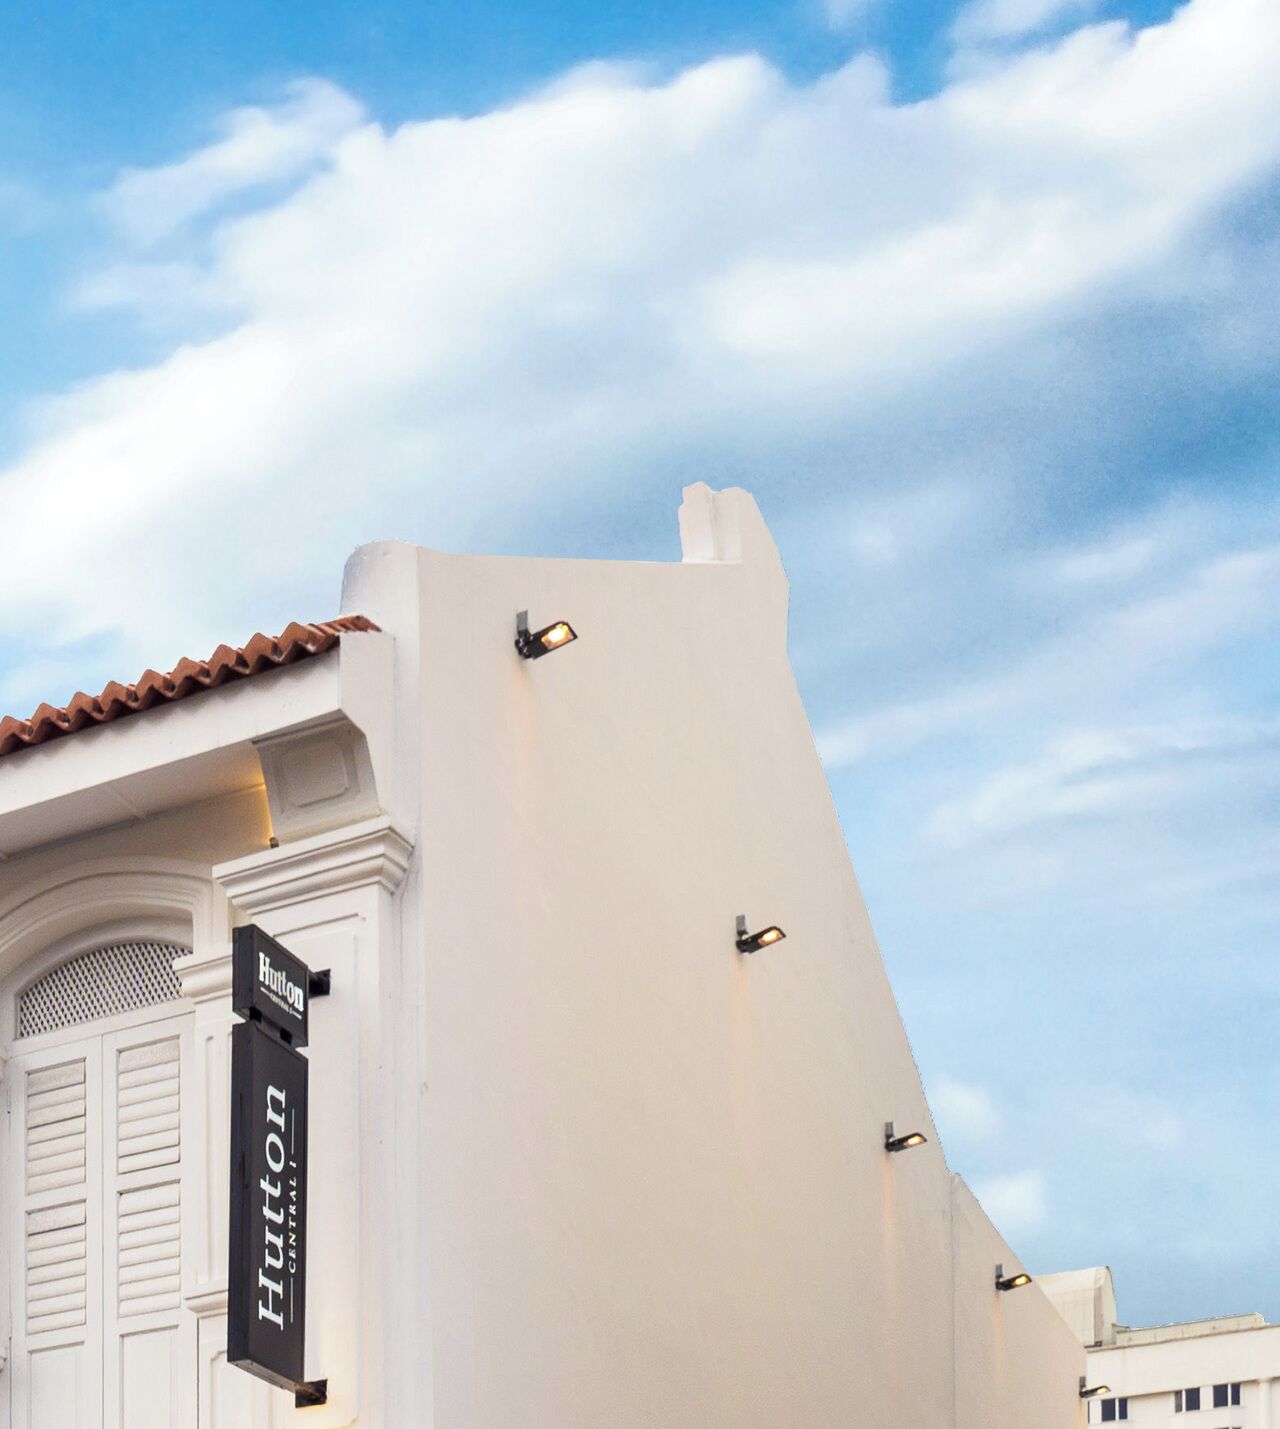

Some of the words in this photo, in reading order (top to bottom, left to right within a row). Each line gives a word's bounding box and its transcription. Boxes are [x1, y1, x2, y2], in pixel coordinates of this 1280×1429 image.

[258, 951, 304, 1012] Hutton
[258, 1084, 286, 1331] Hutton
[288, 1176, 297, 1274] CENTRAL
